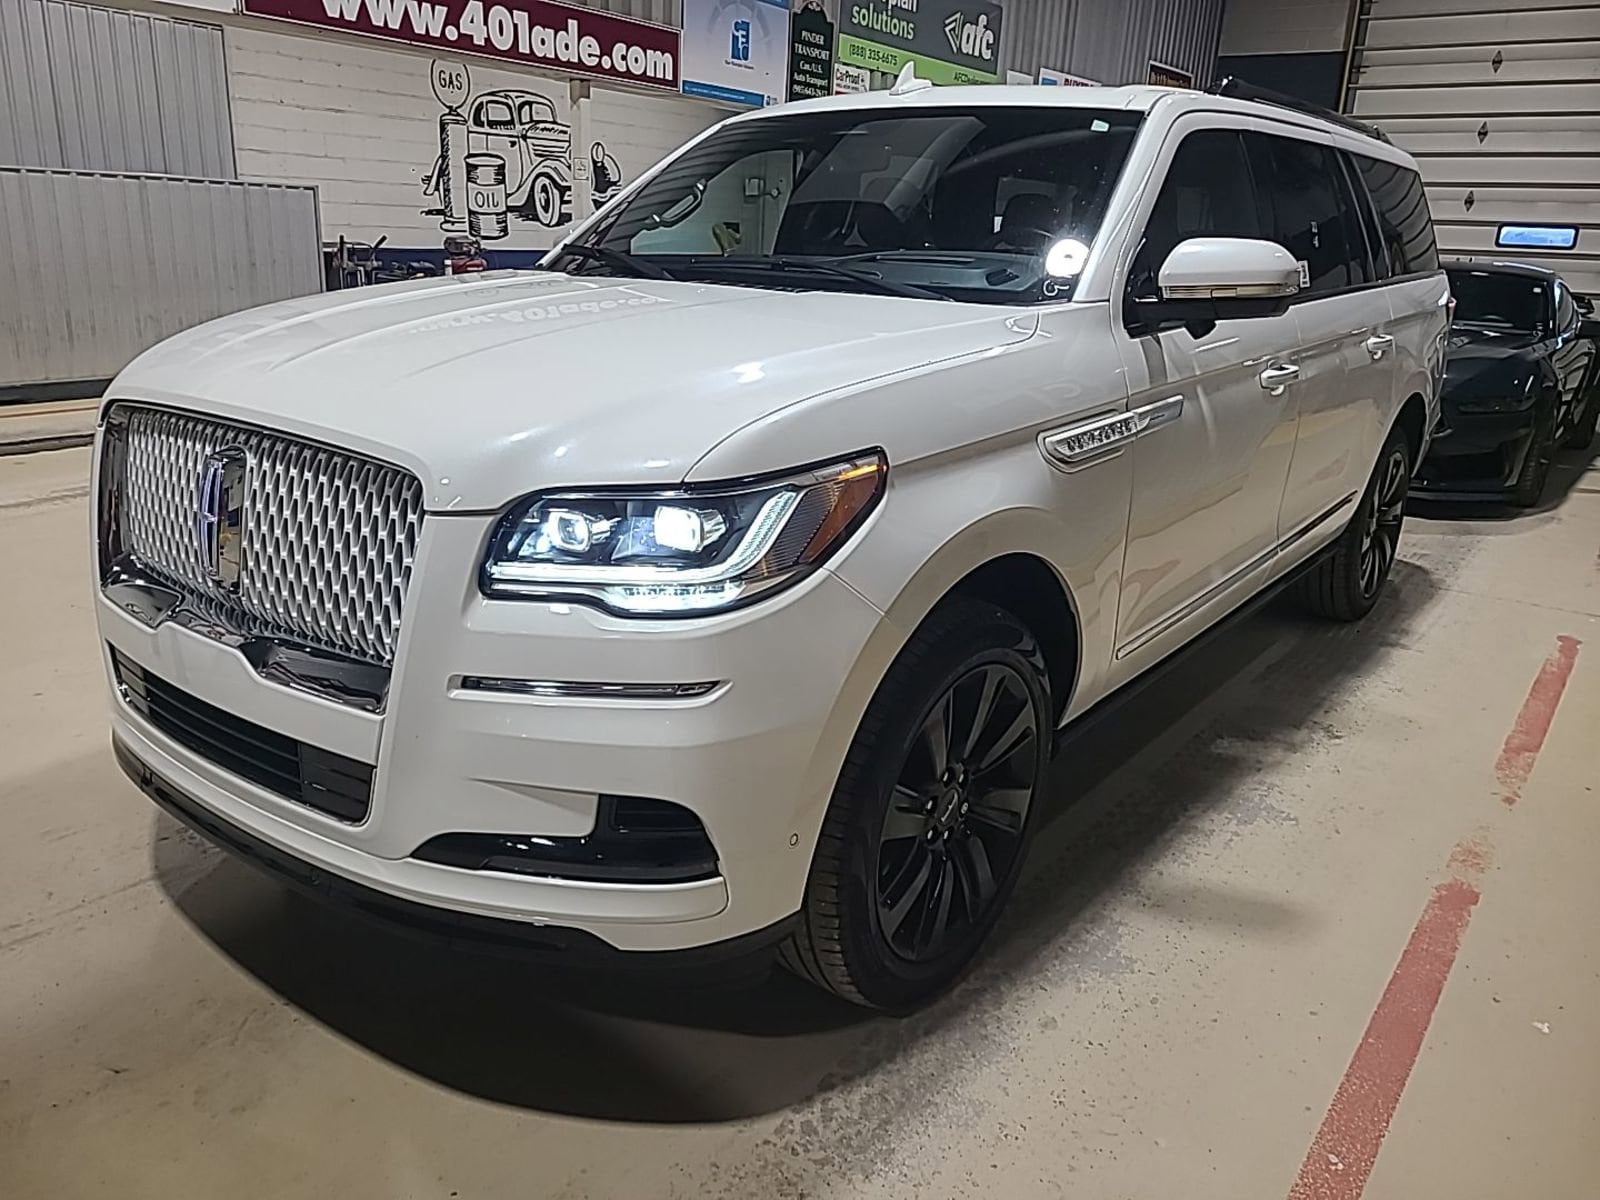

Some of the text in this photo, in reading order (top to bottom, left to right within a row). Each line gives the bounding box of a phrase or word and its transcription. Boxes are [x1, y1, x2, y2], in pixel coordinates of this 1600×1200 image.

[851, 3, 915, 40] solutions
[322, 0, 674, 81] www.401ade.com
[960, 14, 994, 60] afc
[794, 43, 830, 60] TRANSPORT
[849, 43, 898, 66] (888) 335-6675
[438, 69, 463, 91] GAS
[836, 68, 861, 85] CarProof
[474, 190, 499, 208] OIL
